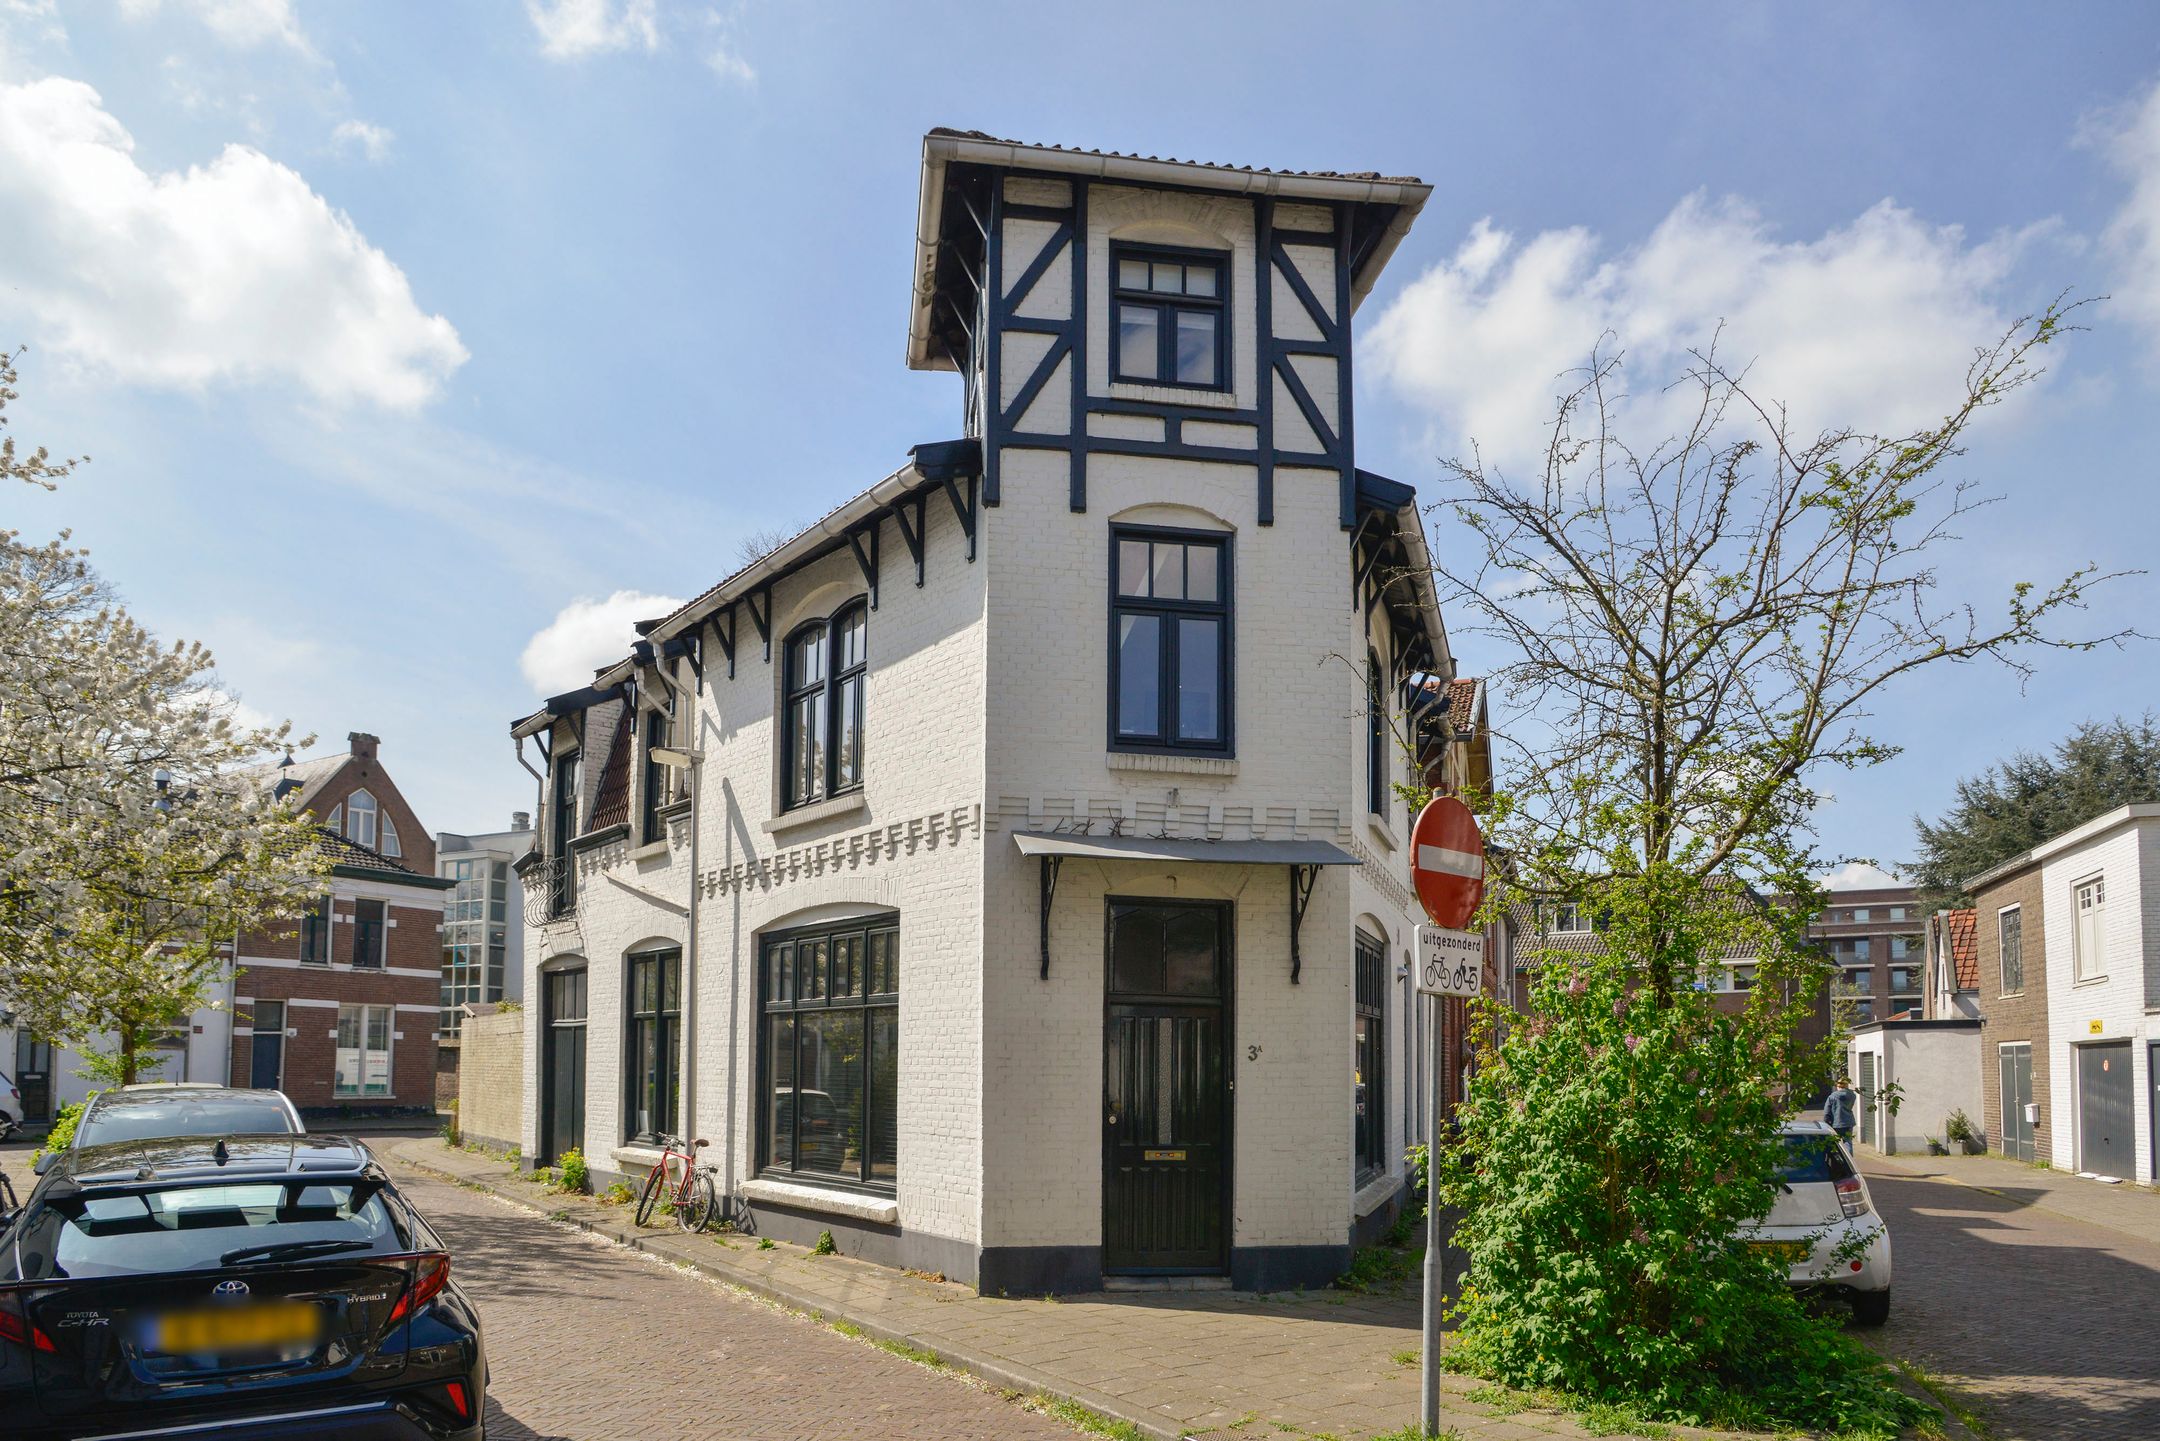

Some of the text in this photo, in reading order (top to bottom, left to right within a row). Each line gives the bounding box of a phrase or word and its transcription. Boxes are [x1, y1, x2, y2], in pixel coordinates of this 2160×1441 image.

[1423, 931, 1481, 951] uitgezonderd
[347, 1294, 381, 1303] HYBRID
[57, 1318, 109, 1327] C-HR
